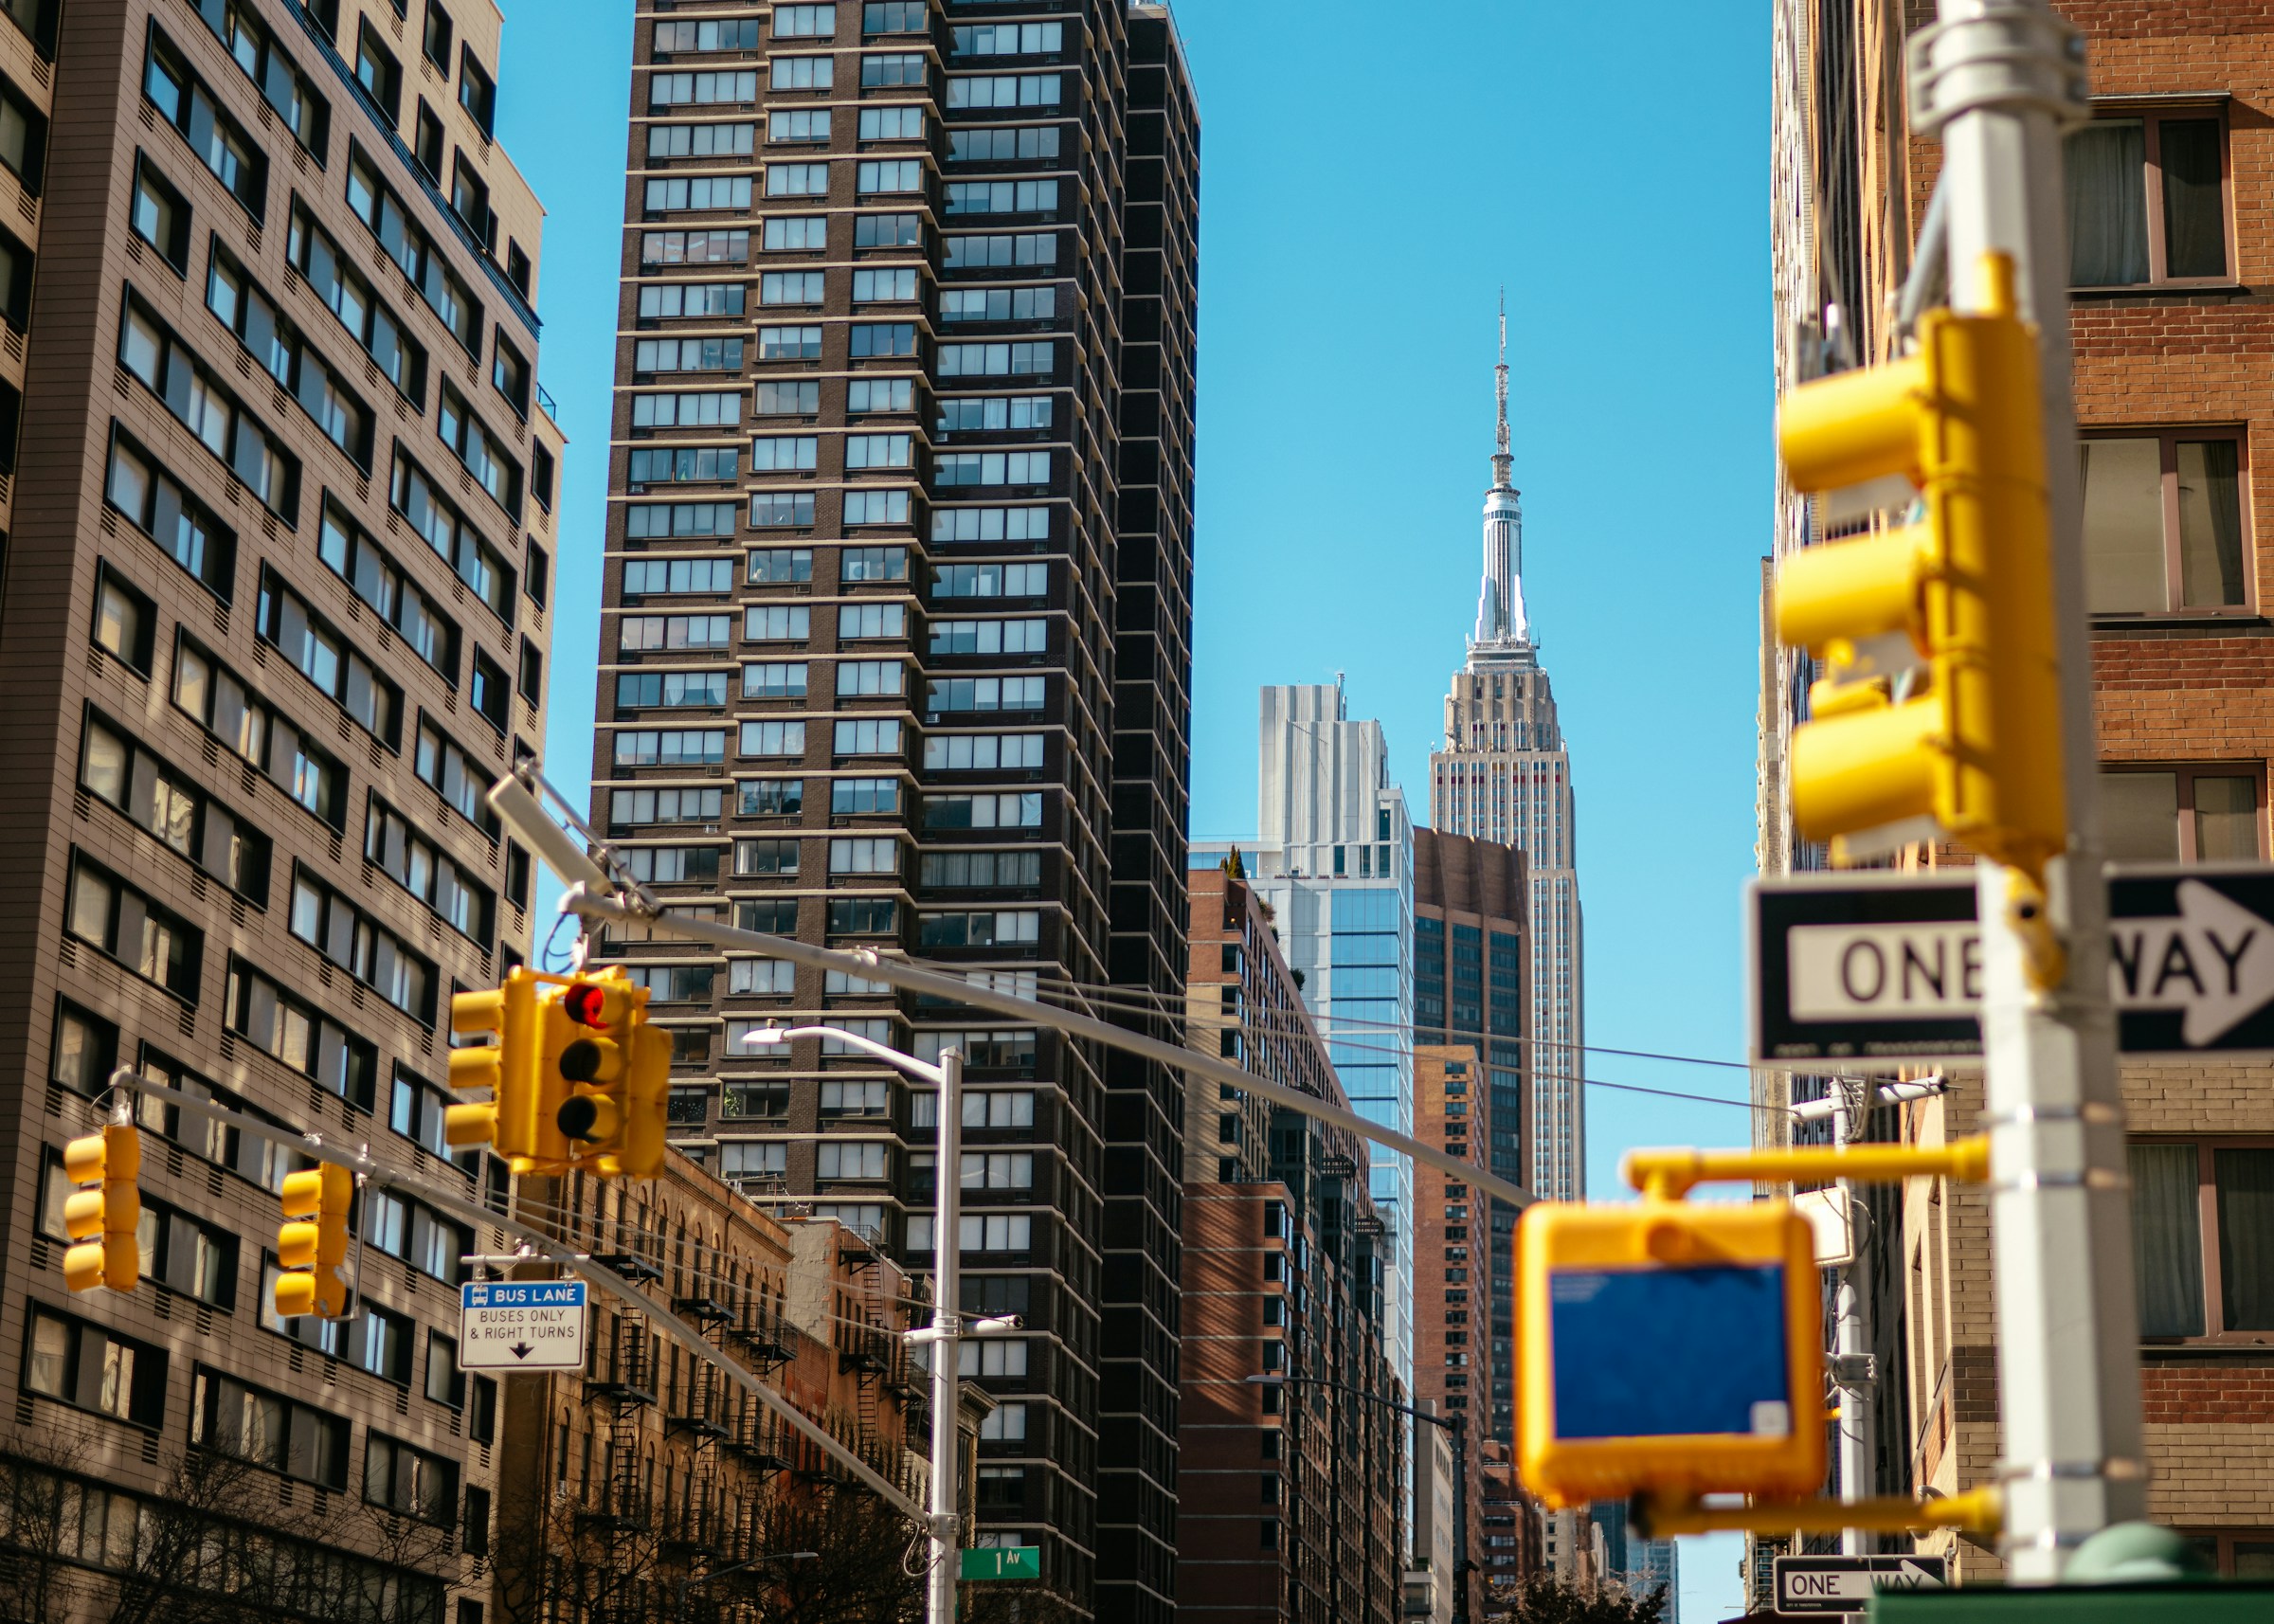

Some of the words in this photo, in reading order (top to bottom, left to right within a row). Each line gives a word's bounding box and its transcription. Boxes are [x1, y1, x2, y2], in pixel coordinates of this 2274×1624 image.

[495, 1290, 526, 1302] BUS
[532, 1289, 576, 1302] LANE
[480, 1309, 524, 1323] BUSES
[531, 1309, 566, 1322] ONLY
[470, 1327, 479, 1339] &
[485, 1326, 524, 1339] RIGHT
[531, 1326, 575, 1338] TURNS
[996, 1552, 1002, 1574] 1
[1006, 1550, 1020, 1564] Av
[1792, 1574, 1841, 1596] ONE
